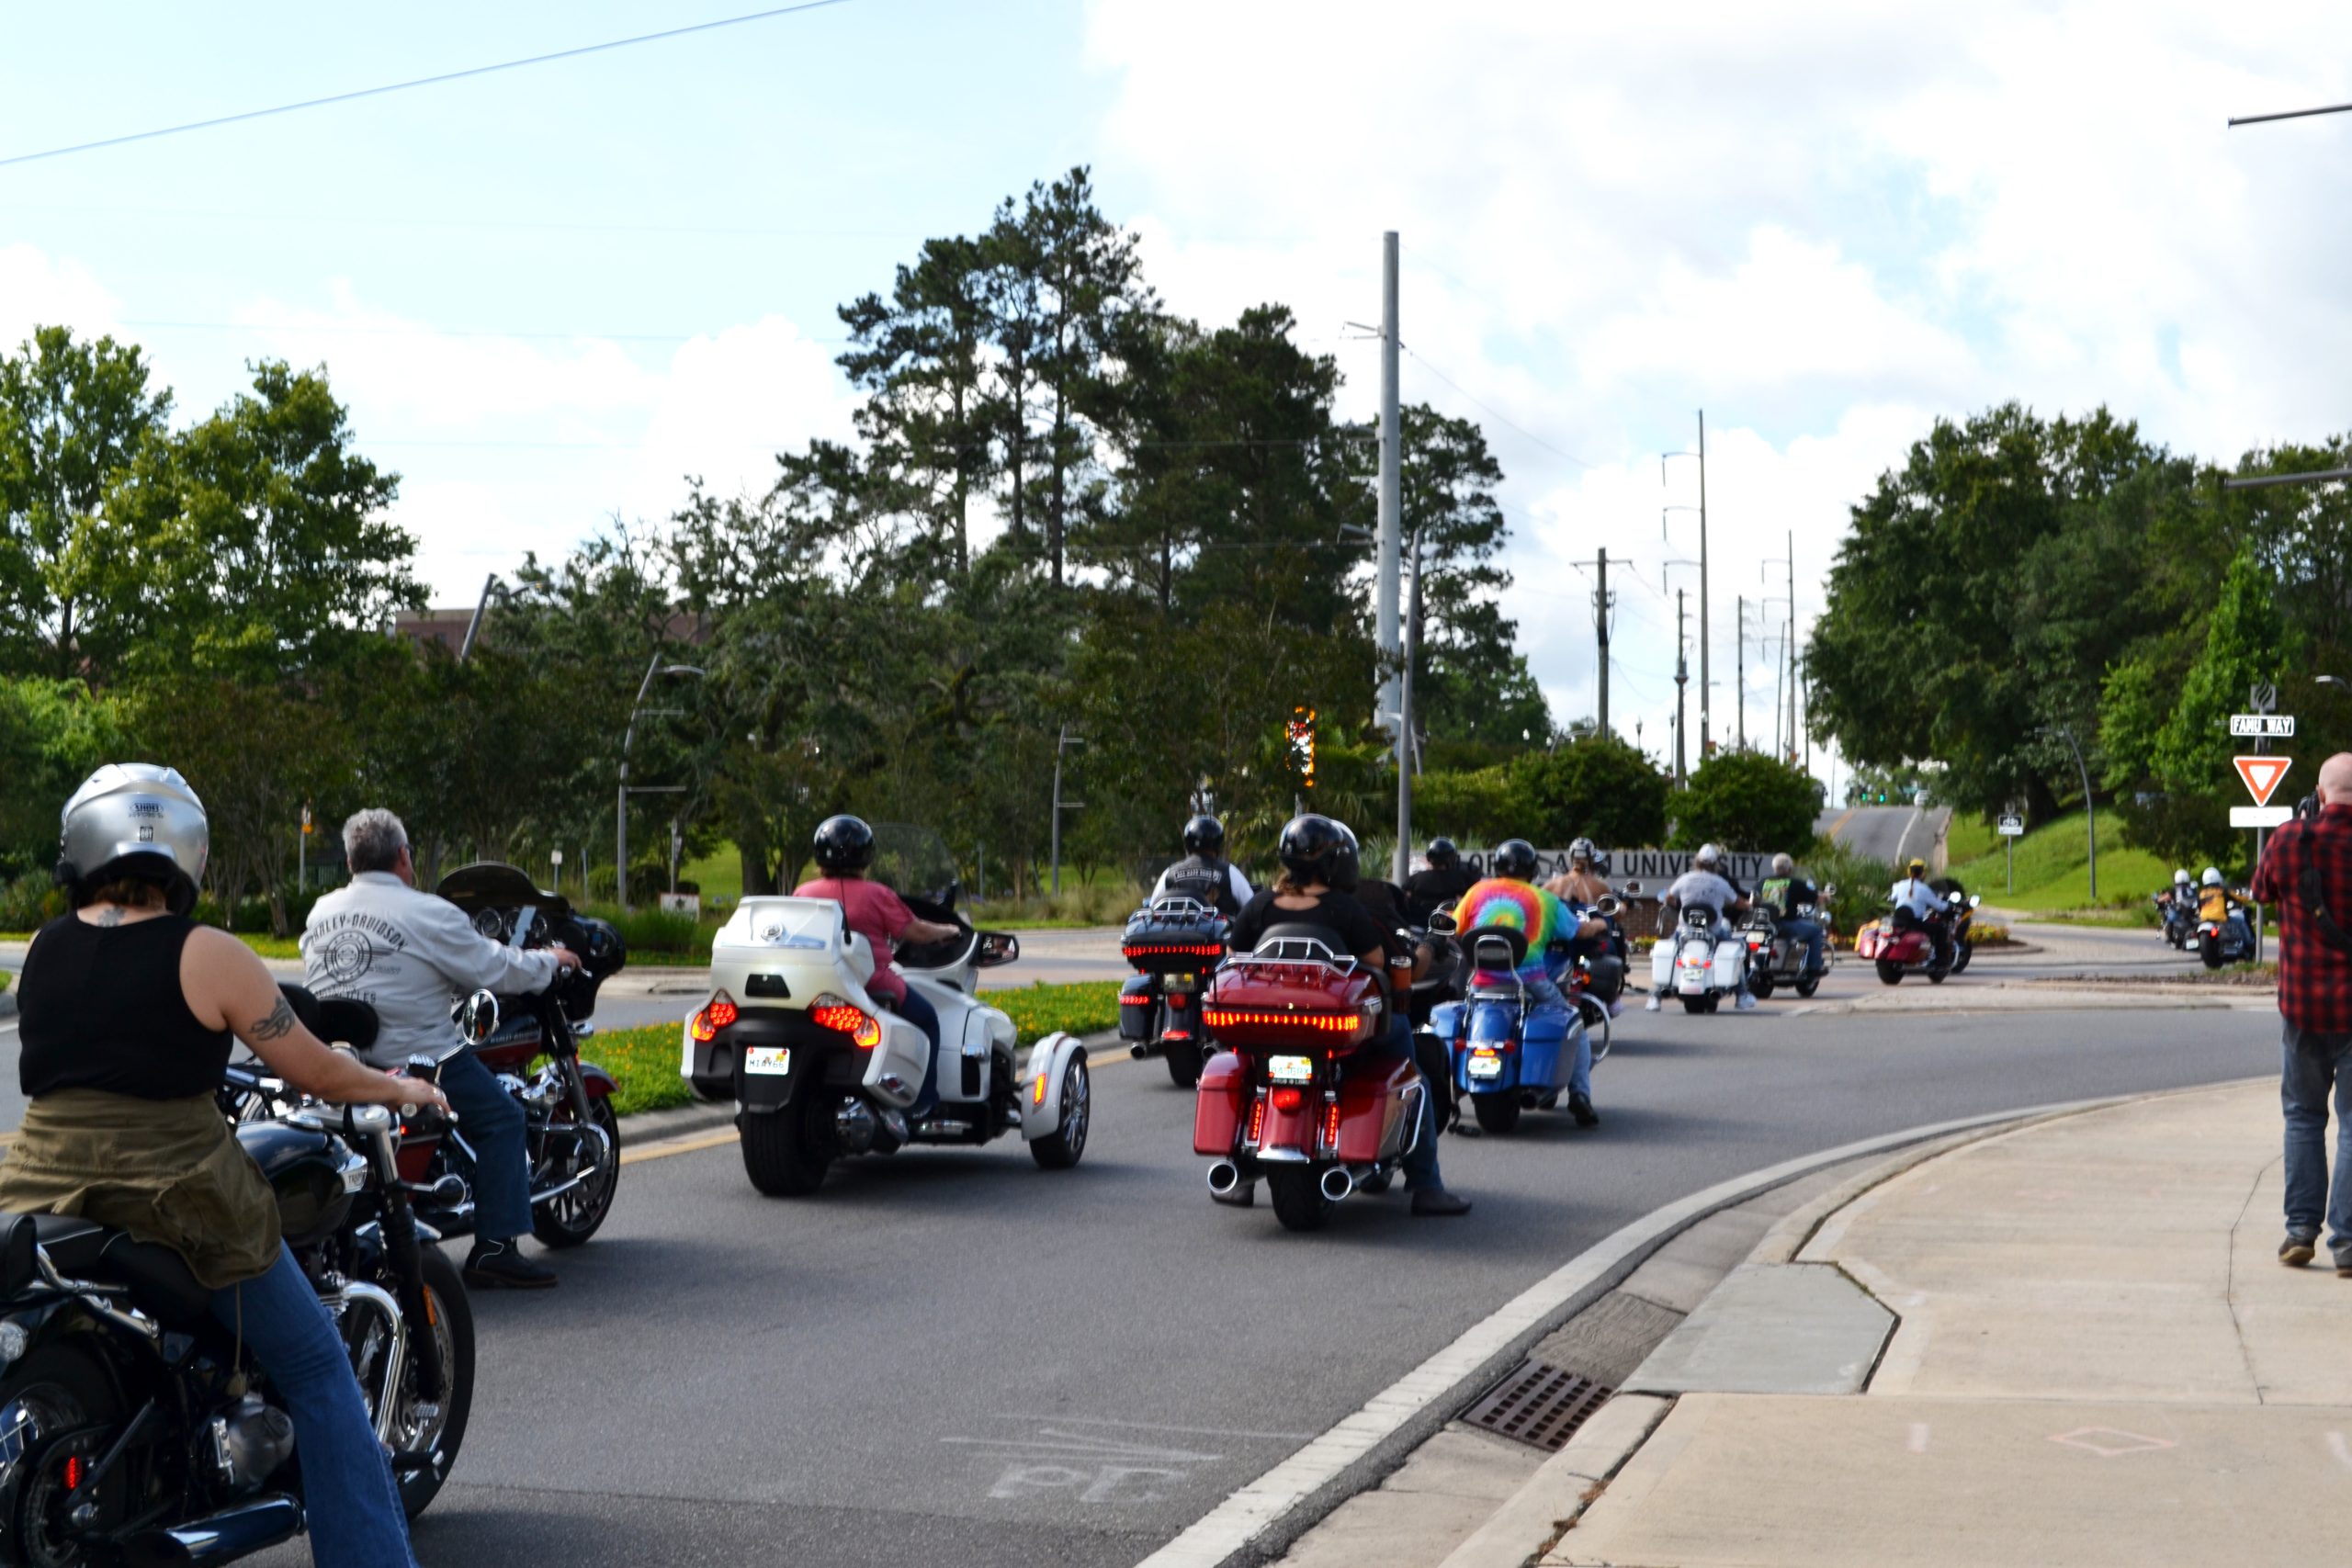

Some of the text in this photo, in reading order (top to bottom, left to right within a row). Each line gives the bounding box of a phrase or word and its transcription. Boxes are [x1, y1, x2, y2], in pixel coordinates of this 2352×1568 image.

[2233, 718, 2291, 733] FAMU WAY
[1624, 853, 1763, 877] UNIVESITY
